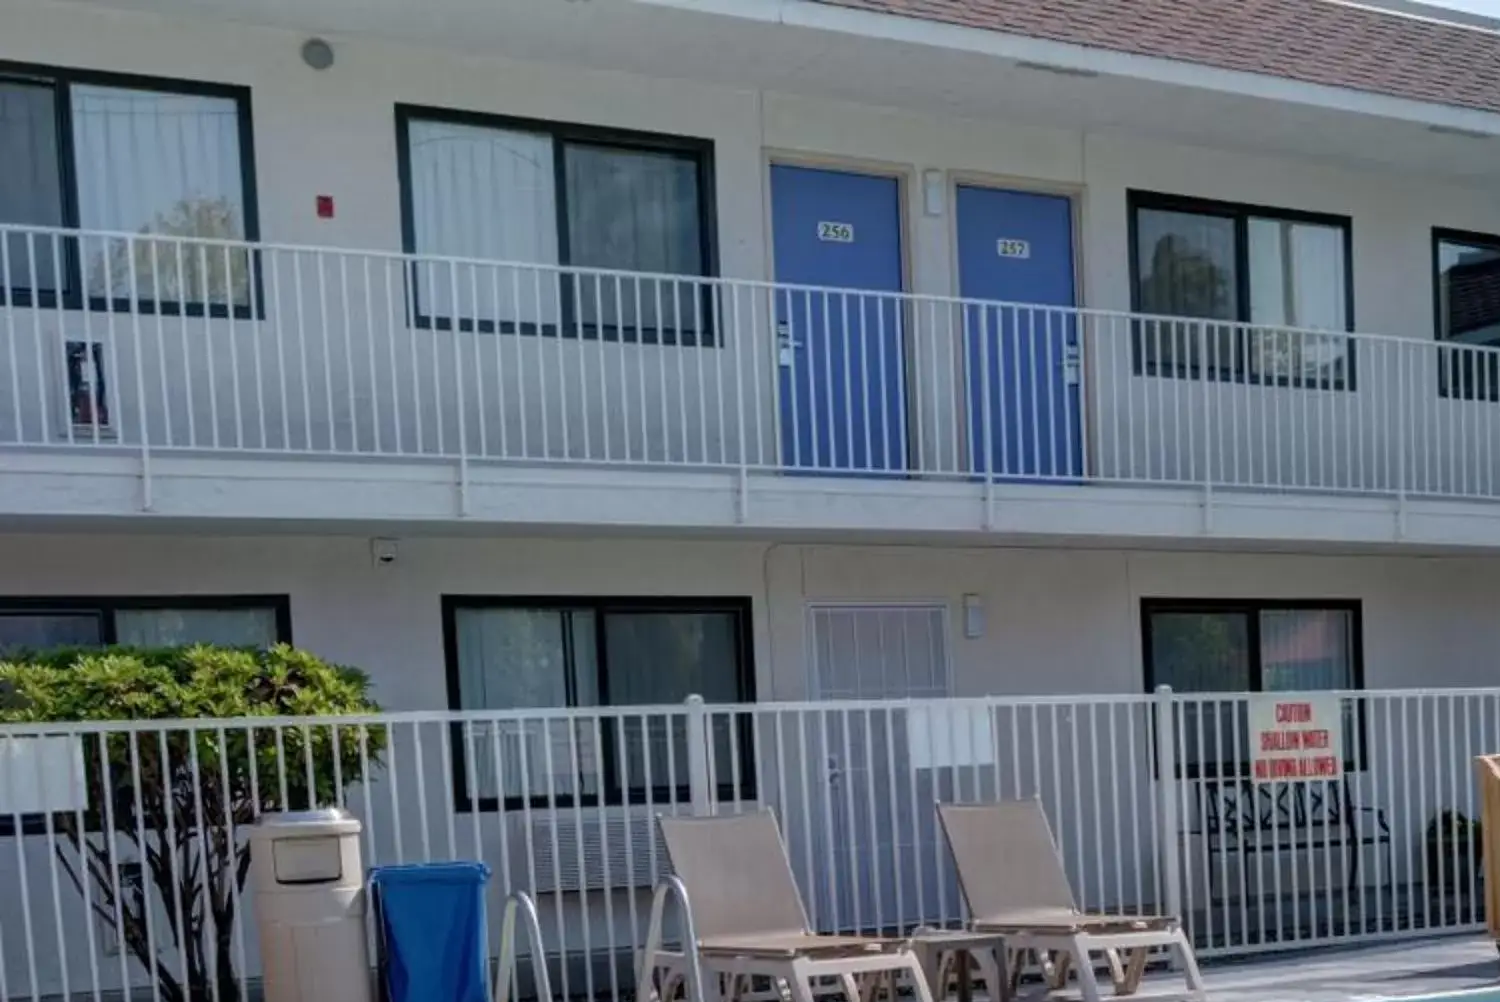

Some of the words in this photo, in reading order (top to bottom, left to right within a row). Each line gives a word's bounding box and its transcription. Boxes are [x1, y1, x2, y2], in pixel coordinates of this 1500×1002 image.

[822, 223, 850, 239] 256
[999, 240, 1025, 255] 257
[1276, 703, 1311, 722] CAUTION
[1261, 731, 1300, 751] SHALLOW
[1302, 729, 1329, 749] WATER
[1255, 759, 1267, 778] NO
[1269, 758, 1298, 778] DIVING
[1300, 756, 1337, 776] ALLOWED
